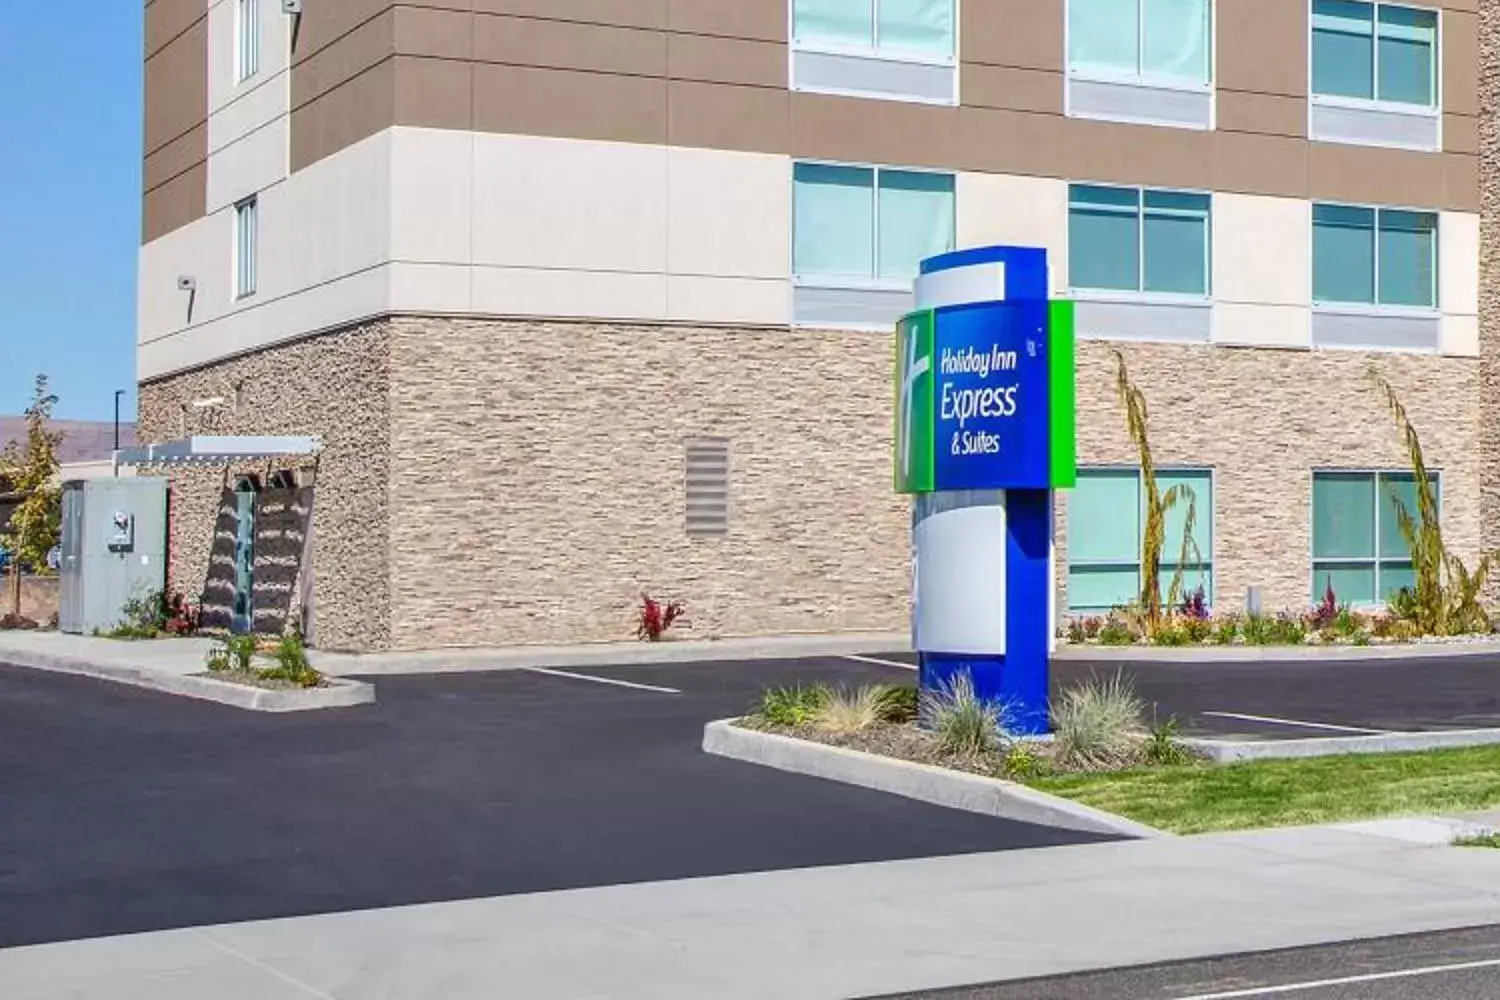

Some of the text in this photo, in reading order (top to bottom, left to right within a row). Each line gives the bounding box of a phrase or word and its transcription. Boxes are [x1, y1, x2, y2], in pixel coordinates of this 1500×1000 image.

[941, 343, 1017, 379] Holiday Inn
[941, 382, 1018, 429] Express
[951, 430, 1001, 456] & Suites
